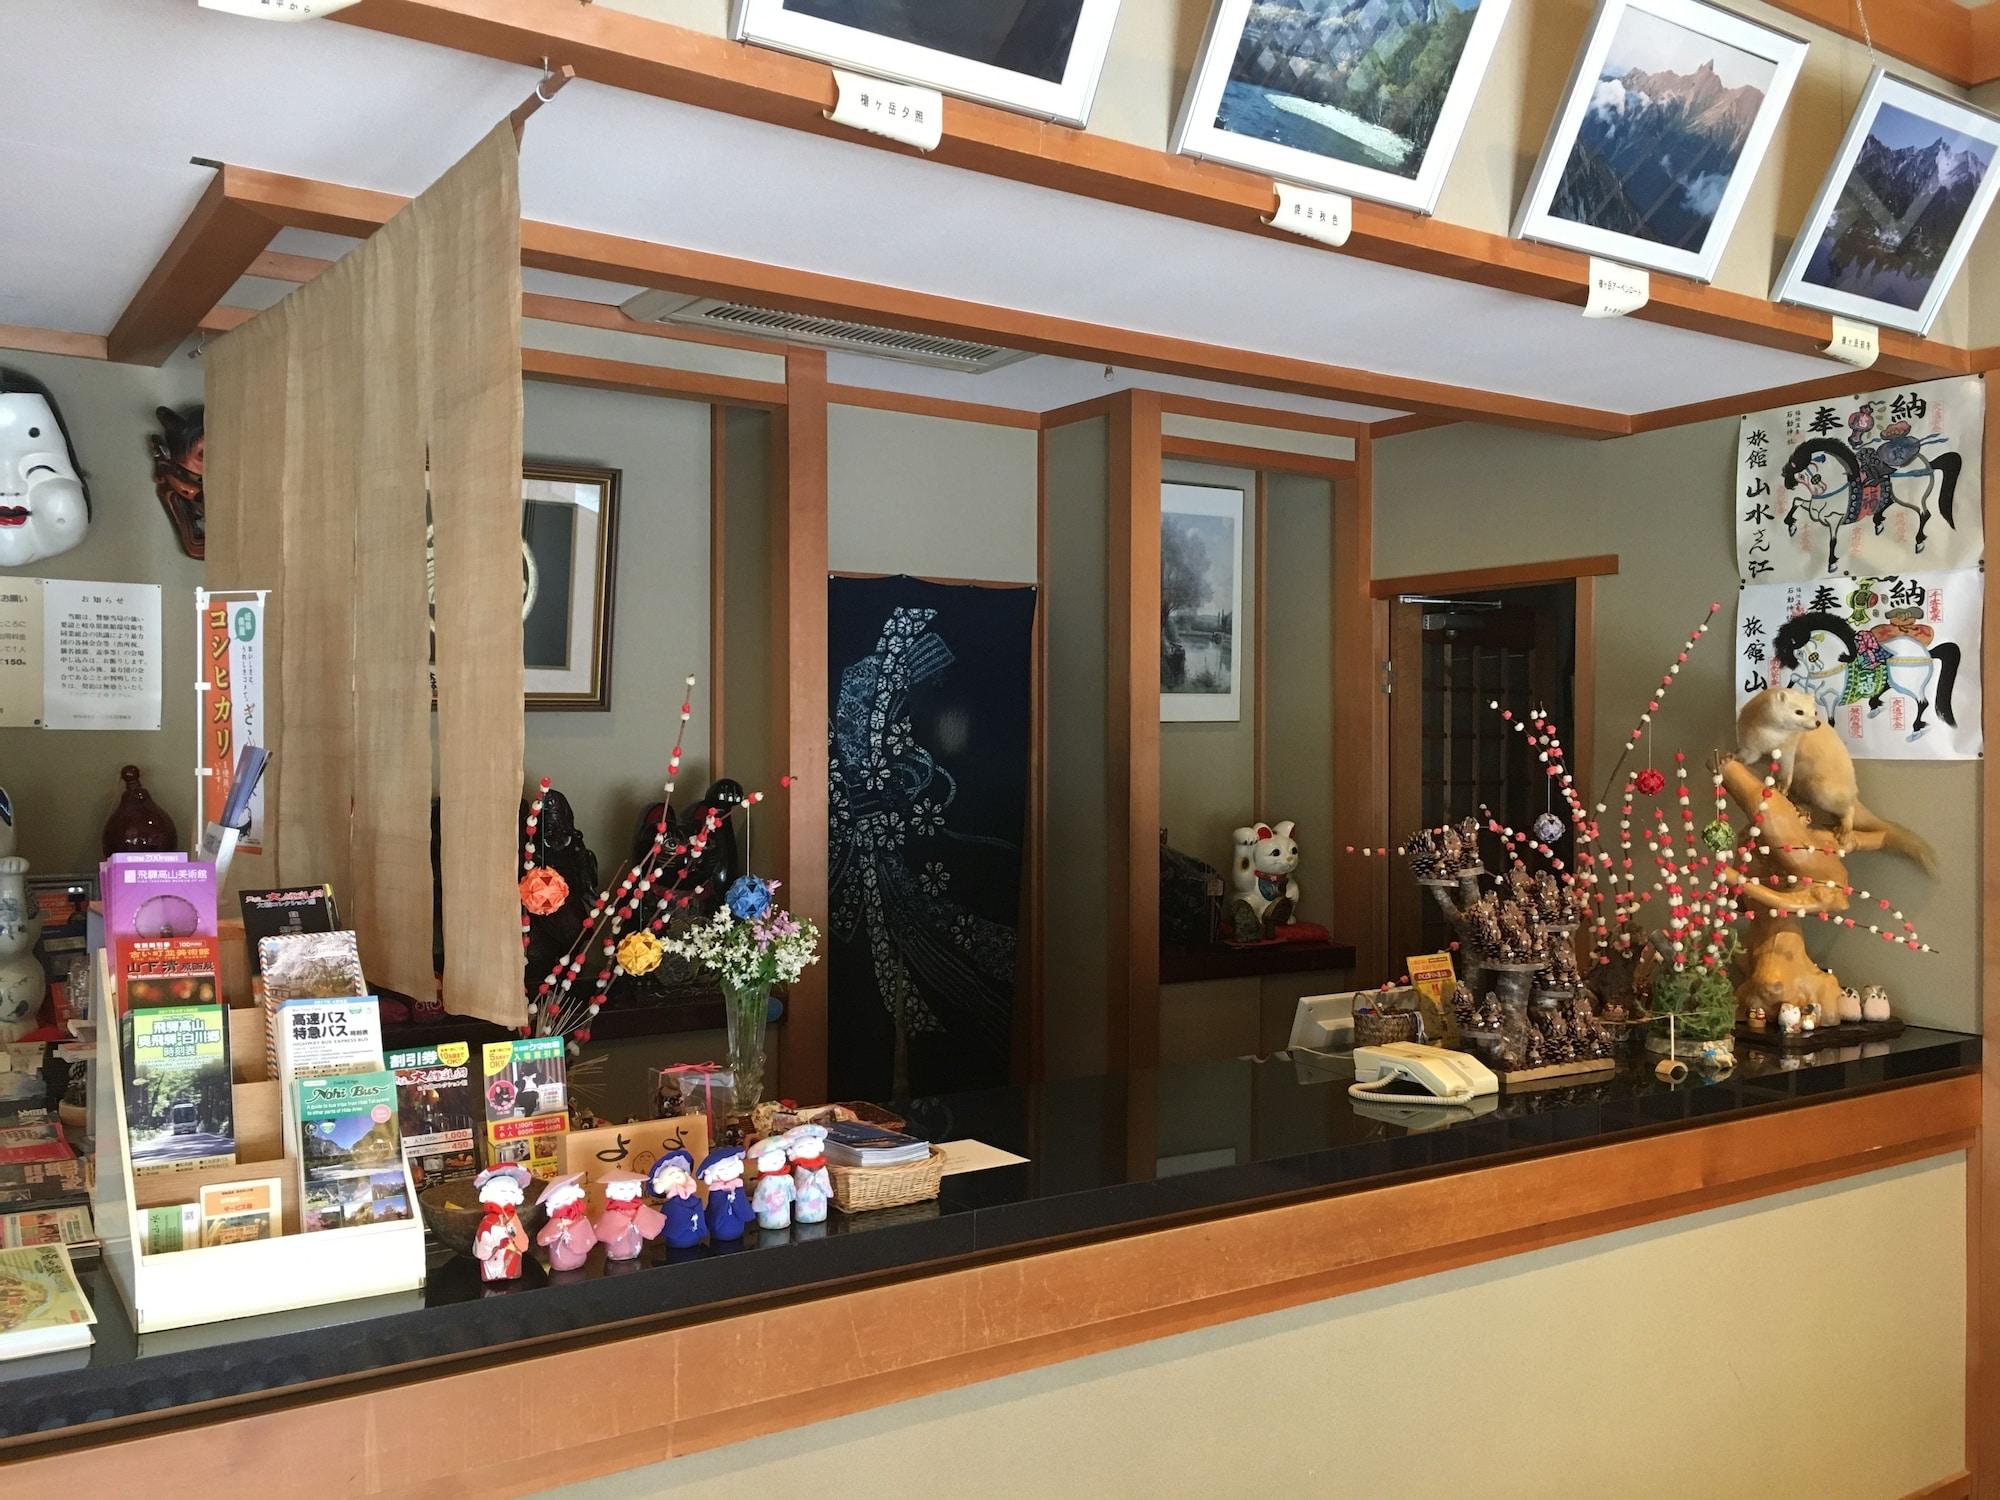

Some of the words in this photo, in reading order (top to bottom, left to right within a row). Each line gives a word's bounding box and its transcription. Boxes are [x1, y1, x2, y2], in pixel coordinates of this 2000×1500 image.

[1807, 406, 1844, 437] 奉
[1890, 392, 1926, 423] 納
[81, 596, 124, 604] お知らせ
[1808, 585, 1842, 613] 奉
[1889, 580, 1926, 608] 納
[209, 610, 232, 759] コシヒカリ
[127, 960, 178, 974] 山下清
[292, 1012, 347, 1027] 高速バス
[293, 1025, 348, 1040] 特急バス
[390, 1051, 437, 1068] 割引券
[306, 1086, 346, 1103] Nohi
[351, 1083, 390, 1097] Bus
